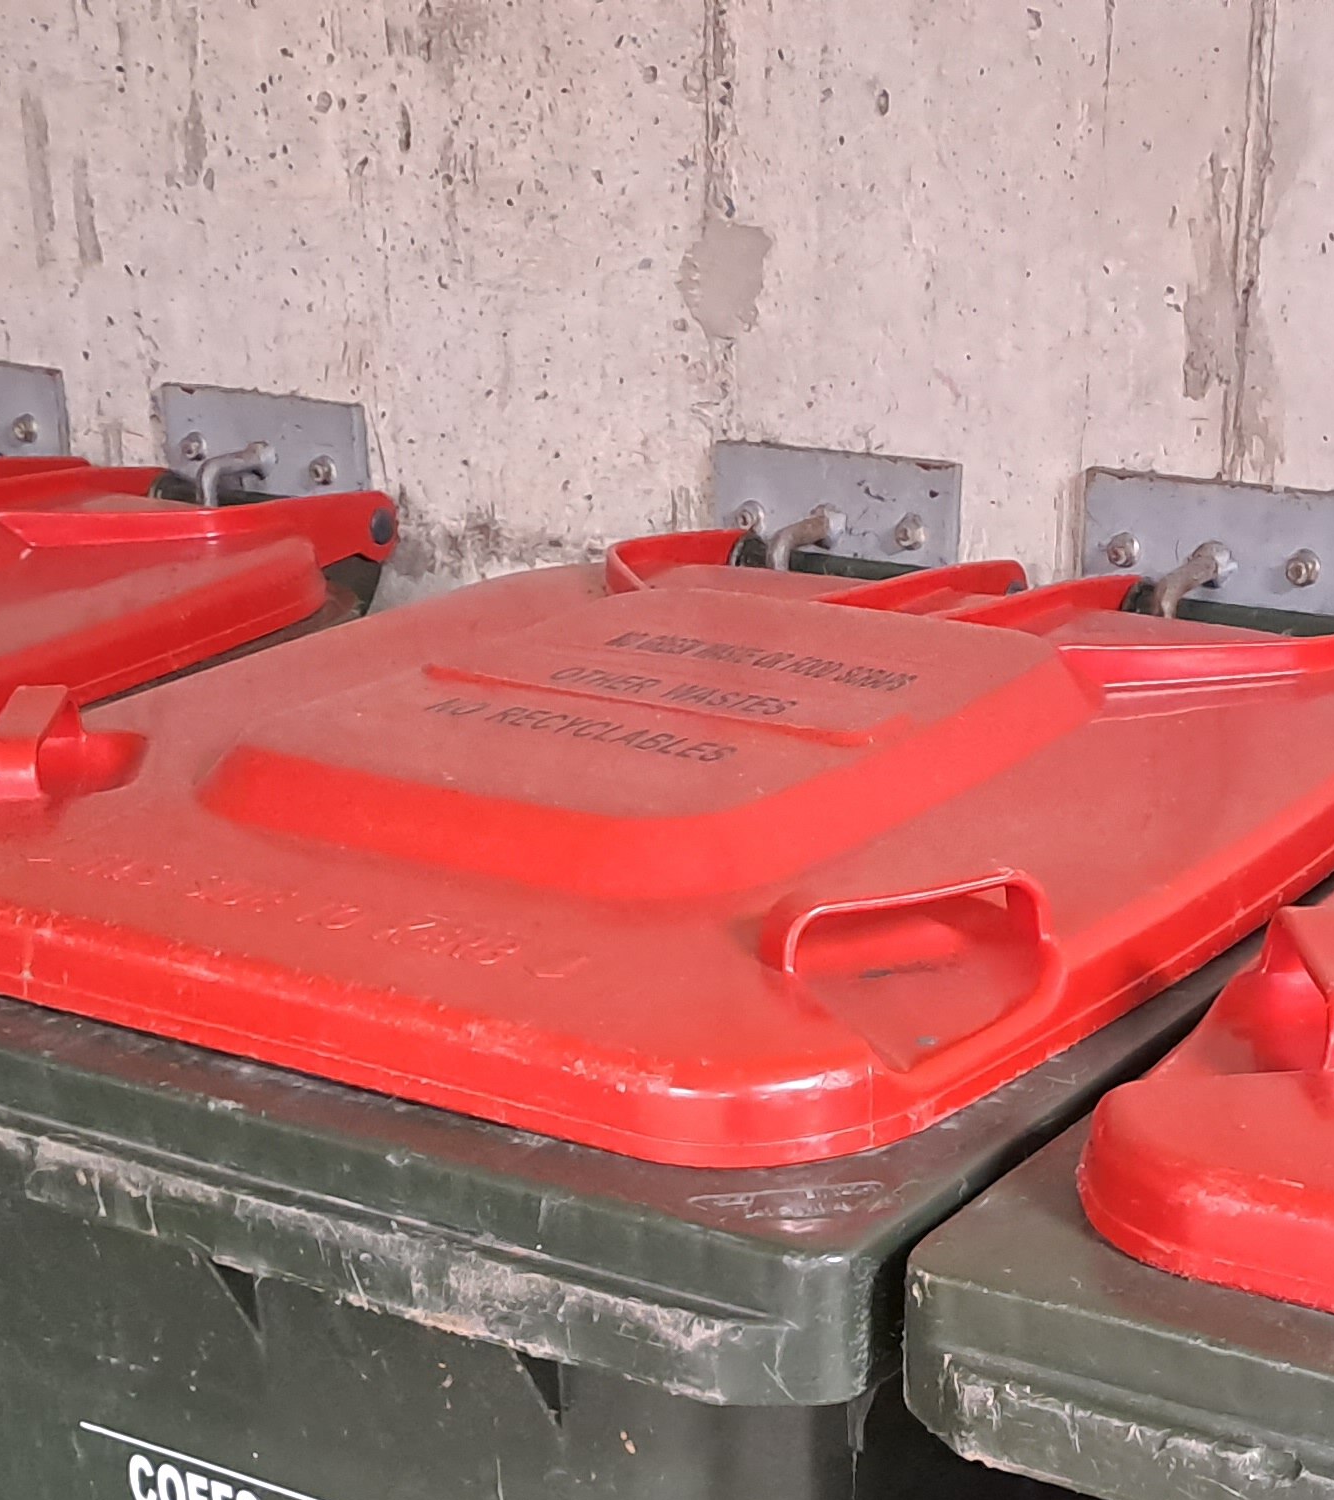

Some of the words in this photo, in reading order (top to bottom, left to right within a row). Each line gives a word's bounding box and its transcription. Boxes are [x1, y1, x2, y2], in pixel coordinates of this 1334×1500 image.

[550, 666, 662, 695] OTHER
[661, 682, 798, 717] WASTES
[425, 697, 486, 716] NO
[486, 706, 737, 763] RECYCLABLES
